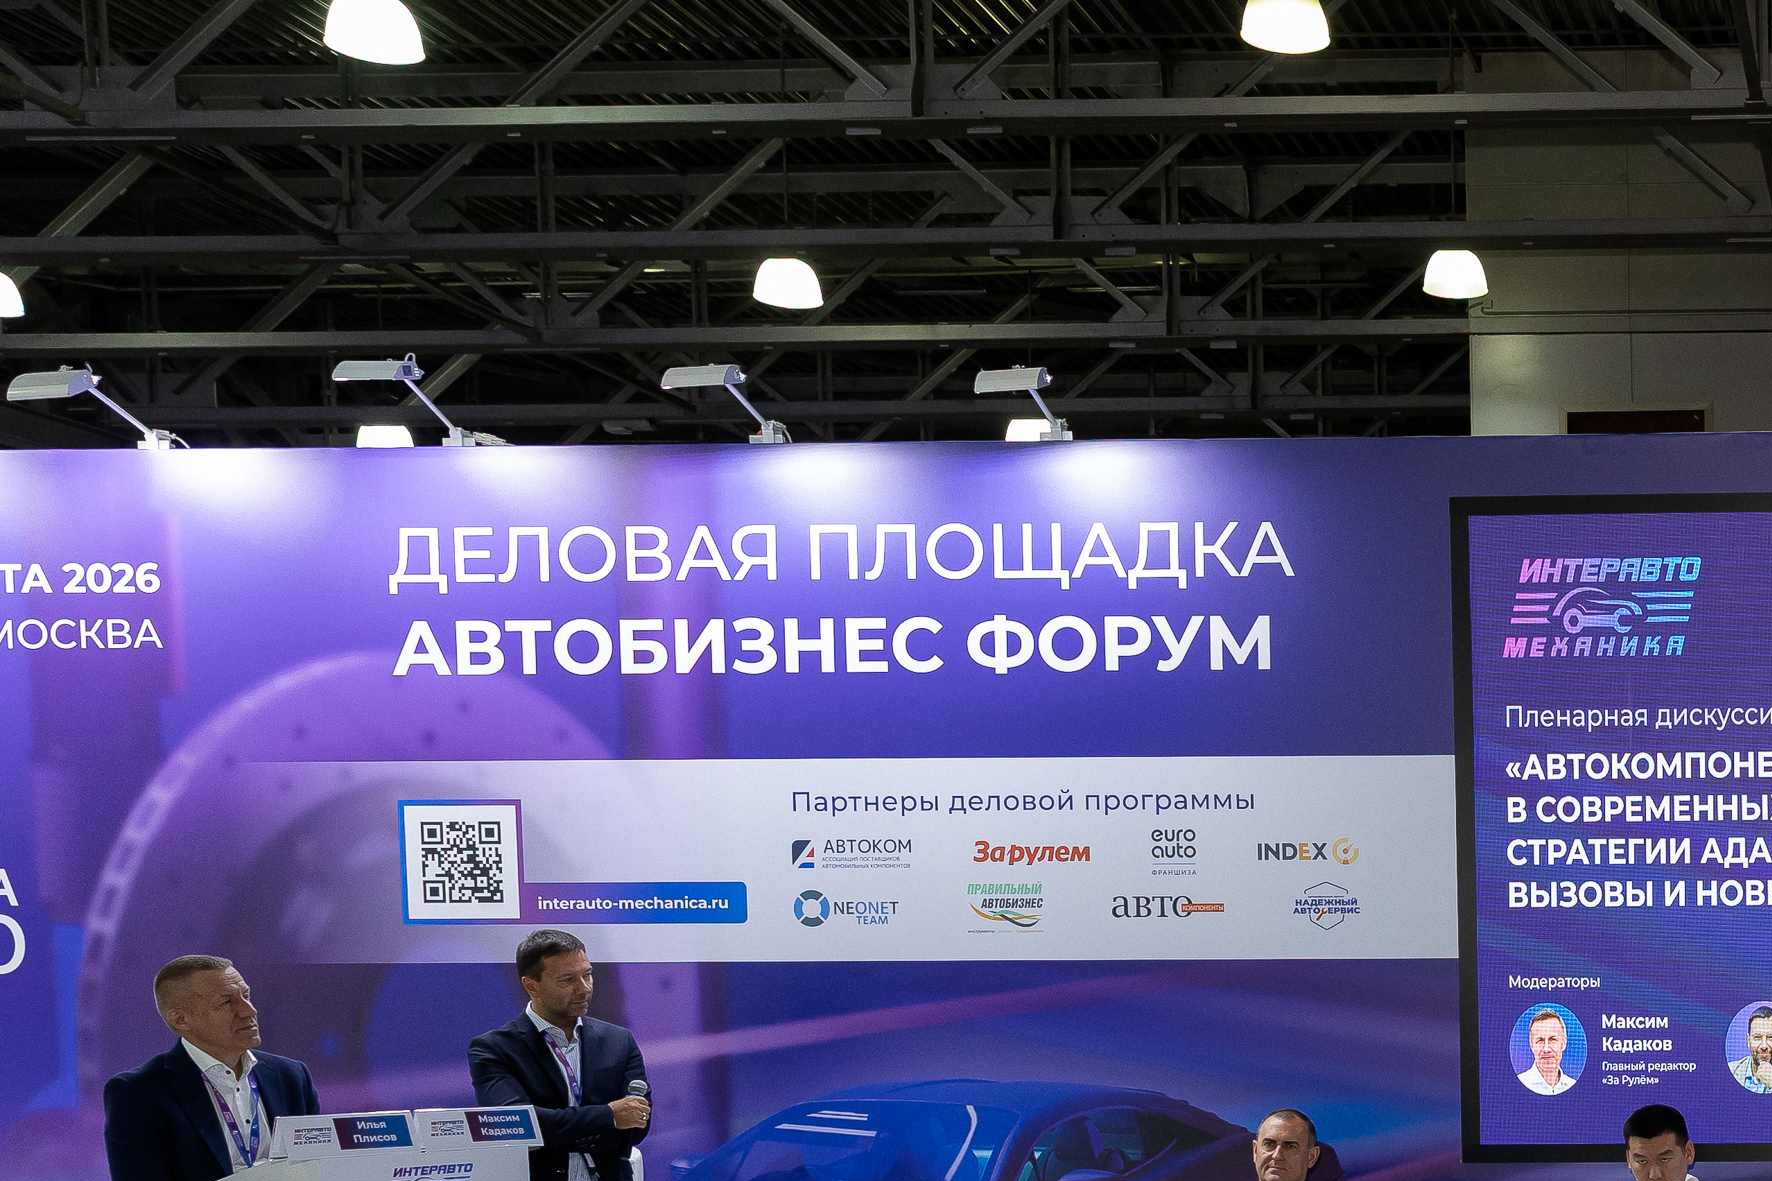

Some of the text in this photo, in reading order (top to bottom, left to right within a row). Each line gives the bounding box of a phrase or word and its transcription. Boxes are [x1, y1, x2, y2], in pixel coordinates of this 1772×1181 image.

[388, 520, 1295, 595] ДЕЛОВАЯ ПЛОЩАДКА
[61, 562, 161, 594] 2026
[1516, 555, 1704, 585] ИНТЕРАВТО
[392, 614, 1271, 676] АВТОБИЗНЕС ФОРУМ
[1501, 633, 1687, 659] МЕХАНИКА
[1505, 705, 1648, 733] Пленарная
[792, 788, 1255, 818] Партнеры деловой программы
[1506, 796, 1528, 823] В
[1151, 828, 1196, 843] euro
[823, 838, 912, 854] АВТОКОМ
[1151, 843, 1197, 859] auto
[1257, 842, 1328, 861] INDEX
[1506, 837, 1691, 866] СТРАТЕГИИ
[966, 880, 1043, 895] ПРАВИЛЬНЫЙ
[1508, 880, 1653, 908] ВЫЗОВЫ
[1664, 880, 1686, 907] И
[537, 895, 729, 910] interauto-mechanica.ru
[833, 901, 900, 915] NEONET
[980, 897, 1044, 909] АВТОБИЗНЕС
[1182, 903, 1224, 912] КОМПОНЕНТЫ
[1294, 898, 1359, 907] НАДЕЖНЫЙ
[855, 915, 889, 925] TEAM
[1508, 974, 1601, 992] Модераторы
[1601, 1013, 1669, 1029] Максим
[1602, 1036, 1673, 1054] Кадаков
[1601, 1060, 1697, 1074] Главный редактор
[356, 1120, 388, 1130] Илья
[478, 1113, 522, 1124] Максим
[353, 1133, 398, 1144] Плисов
[480, 1125, 526, 1138] Кадаков
[392, 1162, 474, 1180] ИНТЕРАВТО
